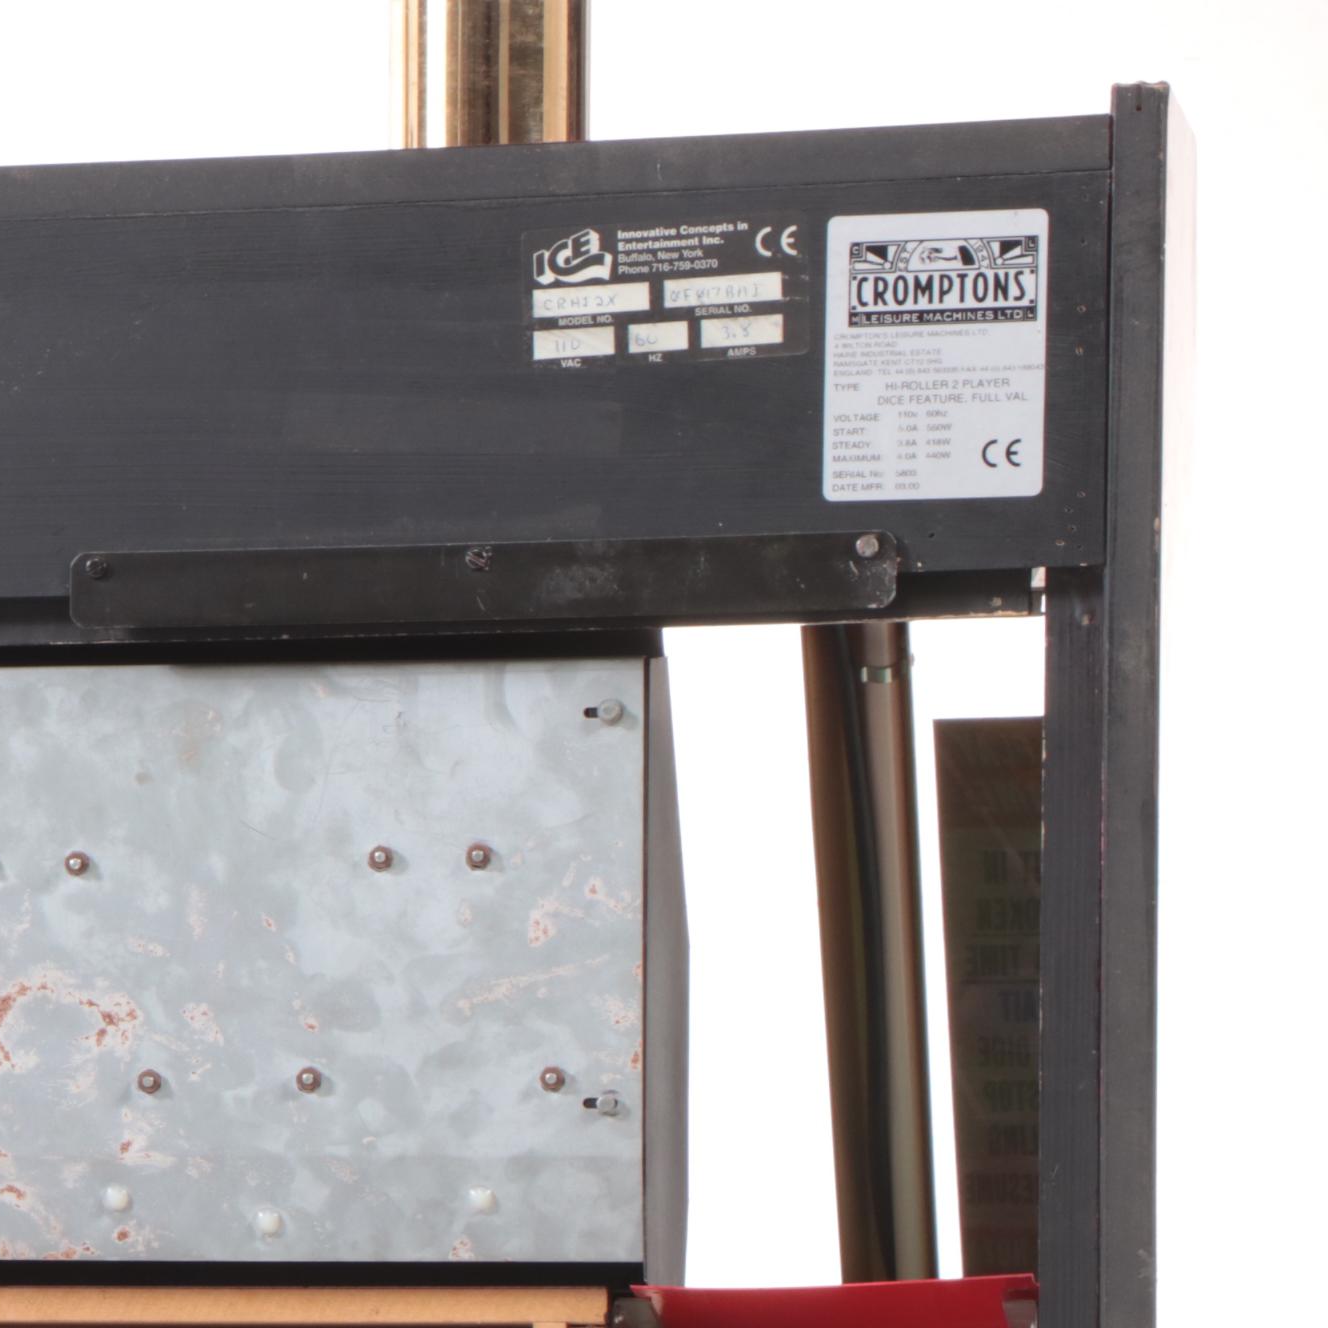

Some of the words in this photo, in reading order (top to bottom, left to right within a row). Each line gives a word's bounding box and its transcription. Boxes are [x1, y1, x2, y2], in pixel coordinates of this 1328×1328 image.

[618, 227, 677, 239] Innovative
[680, 224, 734, 236] Concepts
[737, 221, 748, 231] in
[618, 237, 701, 251] Entertainment
[703, 234, 724, 245] Inc.
[533, 228, 613, 285] ICE
[618, 251, 656, 263] Buffalo,
[658, 250, 678, 260] New
[680, 248, 704, 259] York
[618, 265, 649, 275] Phone
[652, 259, 718, 273] 716-759-0370
[856, 270, 1026, 307] CROMPTONS
[695, 305, 731, 317] SERIAL
[733, 304, 752, 314] NO.
[862, 313, 919, 324] LEISURE
[923, 310, 994, 322] MACHINES
[997, 309, 1023, 320] LTD
[558, 315, 594, 326] MODEL
[596, 313, 614, 324] NO.
[649, 353, 663, 363] HZ
[727, 347, 756, 357] AMPS
[561, 357, 581, 368] VAC
[834, 383, 860, 392] TYPE
[885, 380, 949, 392] HI-ROLLER
[951, 380, 959, 390] 2
[962, 378, 1011, 389] PLAYER
[877, 395, 905, 406] DICE
[972, 393, 1001, 403] FULL
[833, 413, 880, 423] VOLTAGE
[832, 428, 865, 436] START
[832, 441, 871, 450] STEADY
[832, 483, 858, 492] DATE
